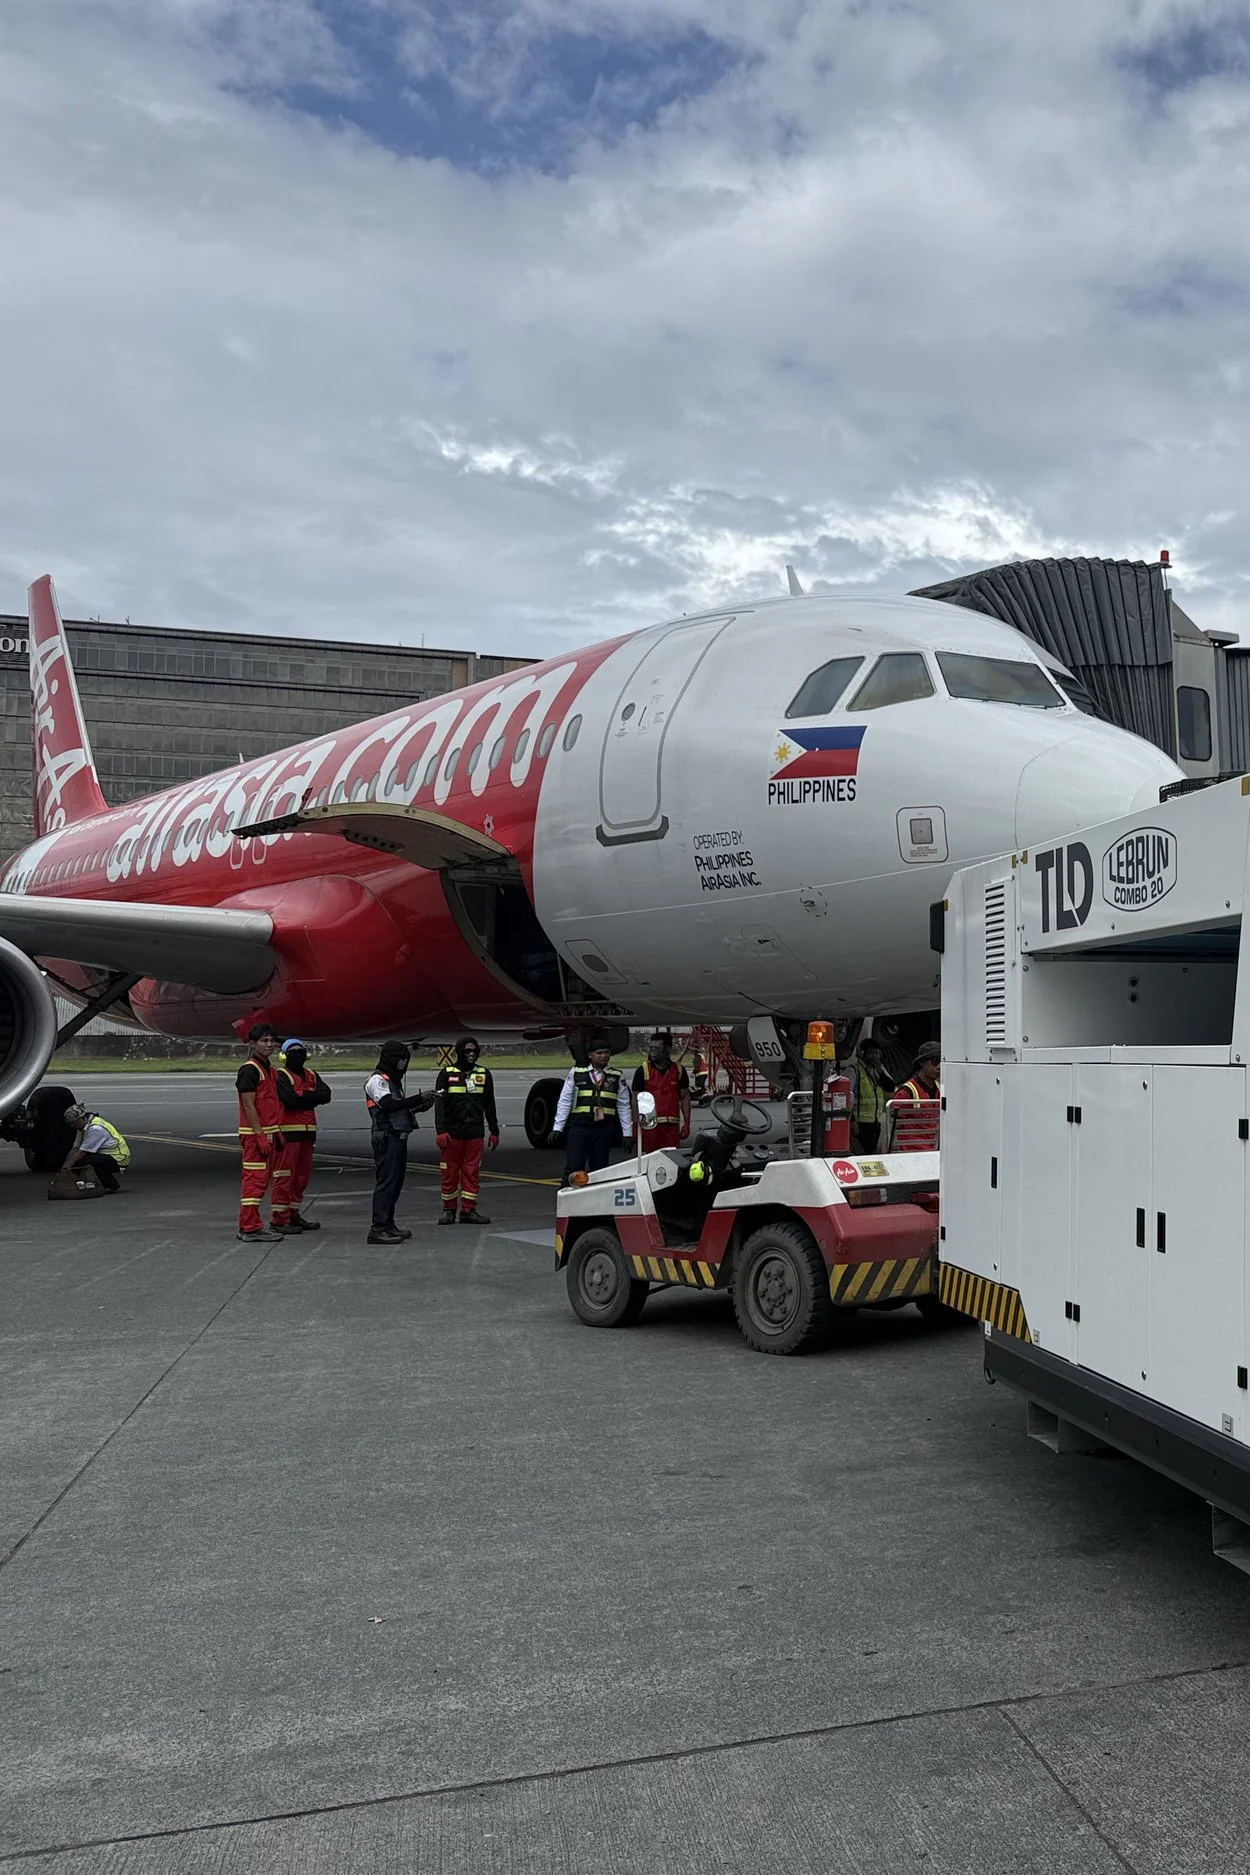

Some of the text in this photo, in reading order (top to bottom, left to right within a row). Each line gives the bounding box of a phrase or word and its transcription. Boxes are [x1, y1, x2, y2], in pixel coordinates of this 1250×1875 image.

[768, 778, 857, 805] PHILIPPINES
[693, 832, 732, 850] OPERATED
[694, 850, 754, 873] PHILIPPINES
[1109, 834, 1169, 885] LEBRUN
[1035, 841, 1094, 934] TLD
[1114, 876, 1164, 906] COMBO 20
[755, 1042, 781, 1057] 950
[614, 1188, 635, 1206] 25
